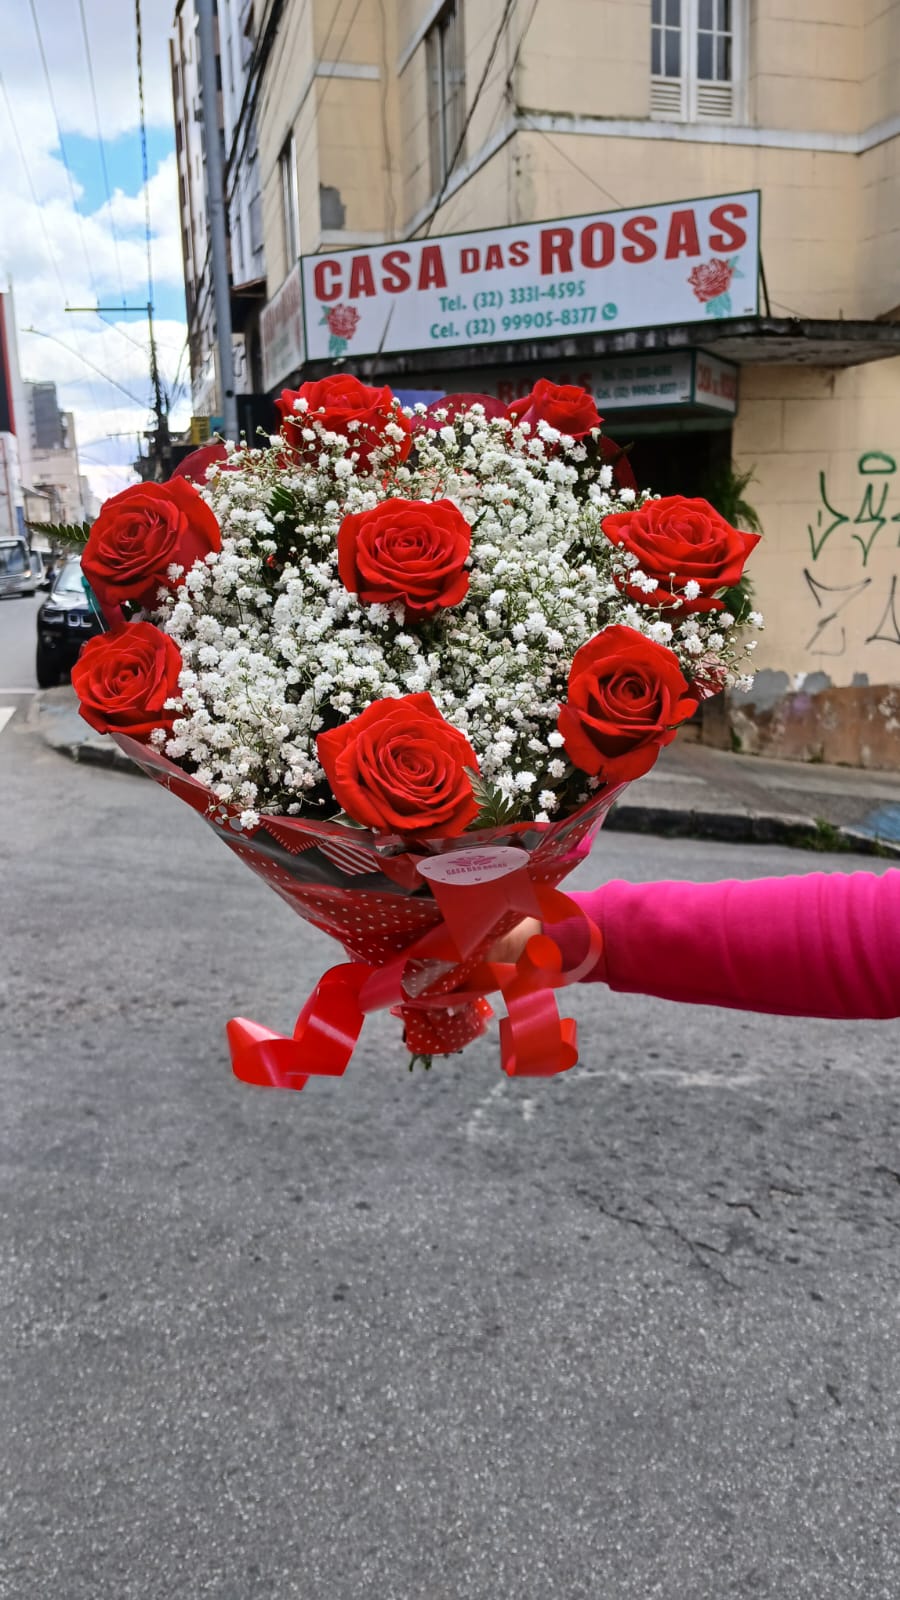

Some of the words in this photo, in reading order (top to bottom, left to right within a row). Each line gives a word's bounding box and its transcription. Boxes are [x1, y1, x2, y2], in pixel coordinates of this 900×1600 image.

[314, 245, 447, 301] CASA
[460, 241, 530, 274] DAS
[540, 203, 748, 275] ROSAS
[439, 296, 467, 312] Tel.
[473, 290, 504, 311] (32)
[510, 280, 586, 305] 3331-4595
[430, 323, 460, 339] Cel.
[466, 318, 496, 338] (32)
[502, 306, 598, 332] 99905-8377
